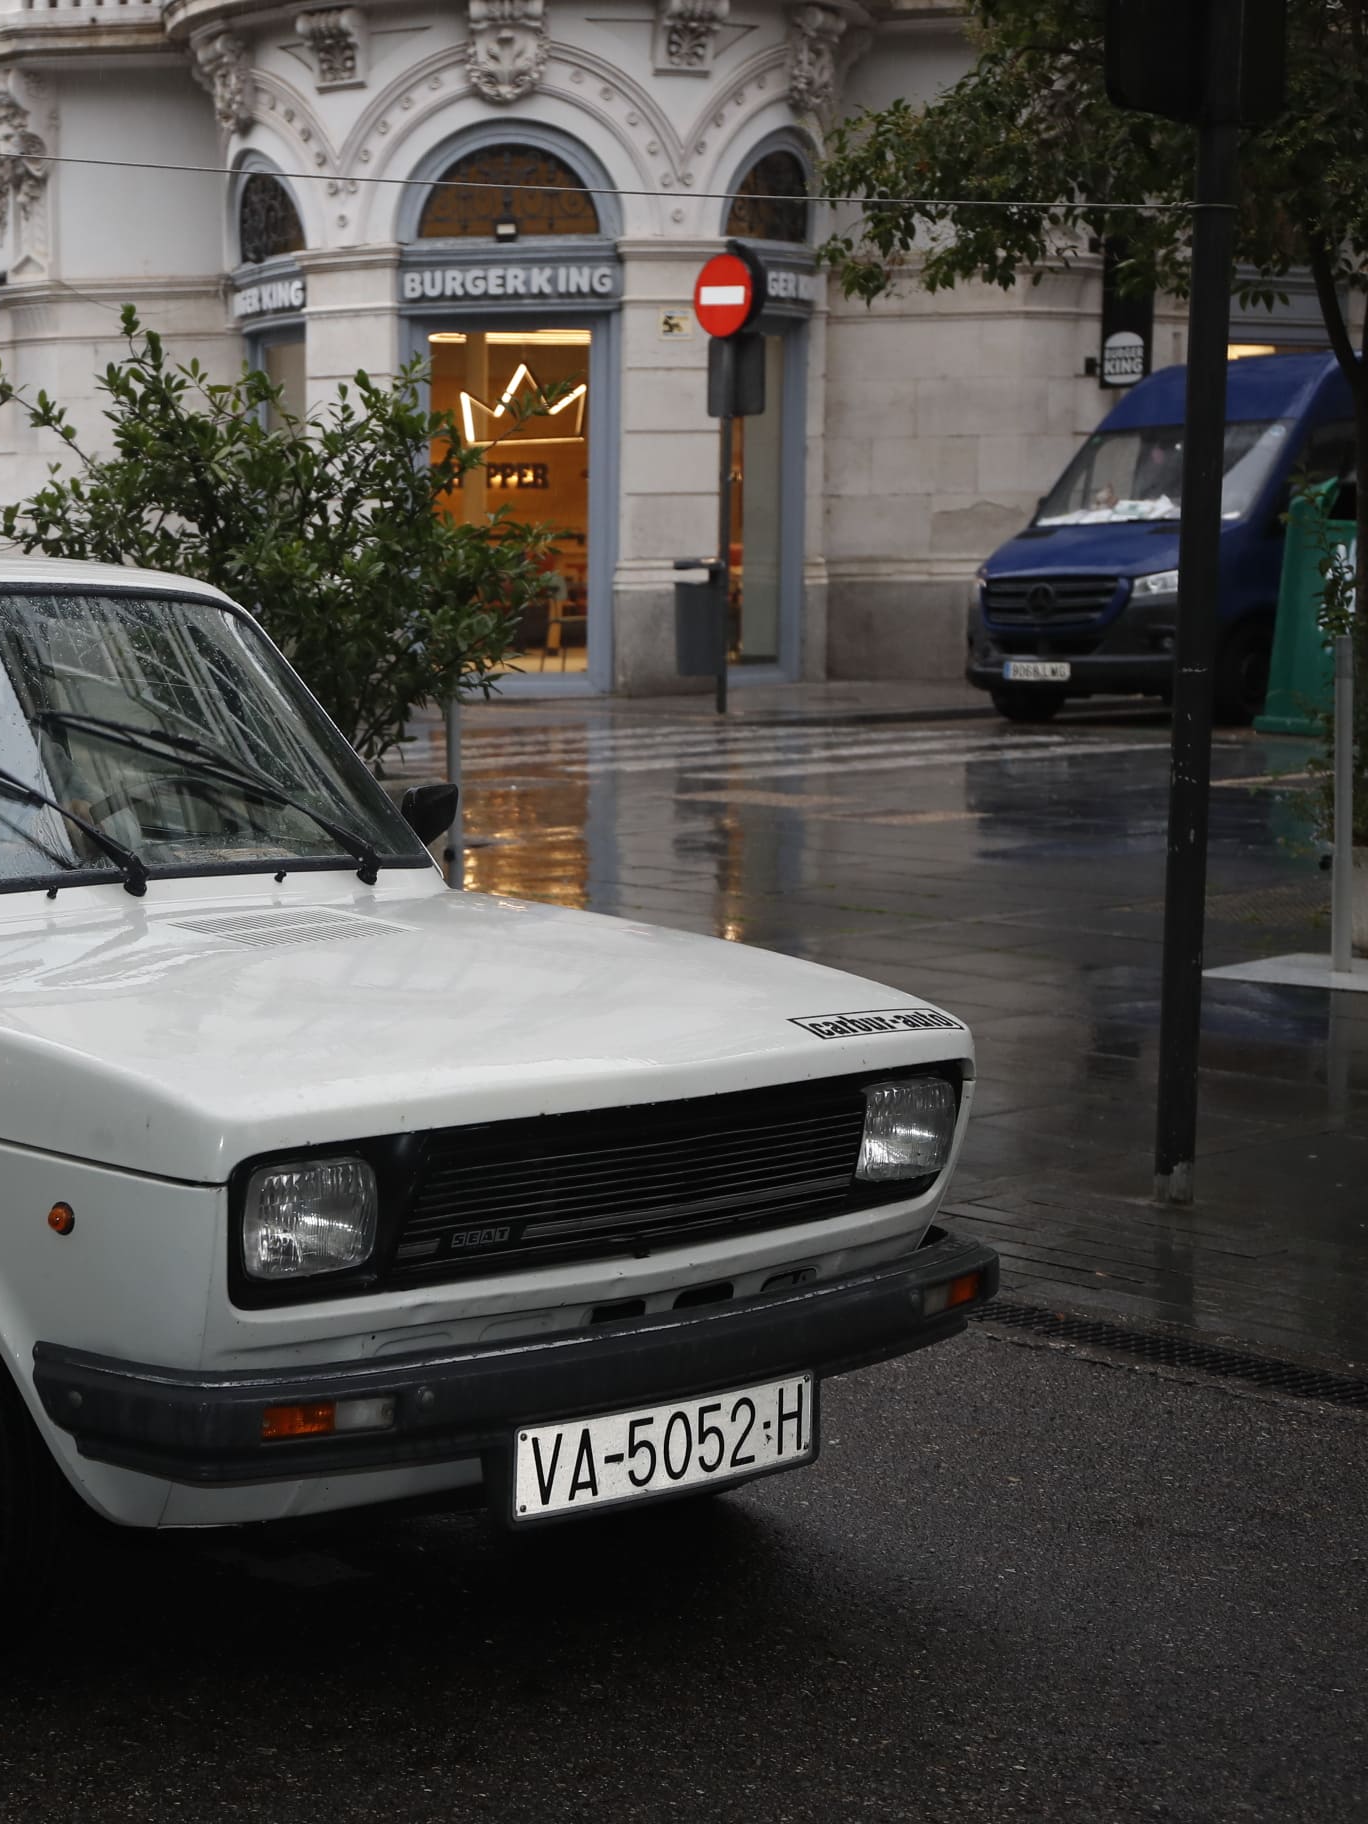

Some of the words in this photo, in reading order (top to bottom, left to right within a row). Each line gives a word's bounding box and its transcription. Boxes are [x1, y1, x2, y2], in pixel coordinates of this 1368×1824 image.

[262, 280, 304, 310] KING
[403, 267, 527, 299] BURGER
[530, 266, 614, 295] KING
[768, 271, 795, 297] GER
[1104, 359, 1144, 374] KING
[808, 1011, 953, 1036] carbur-auto
[451, 1226, 510, 1248] SEAT
